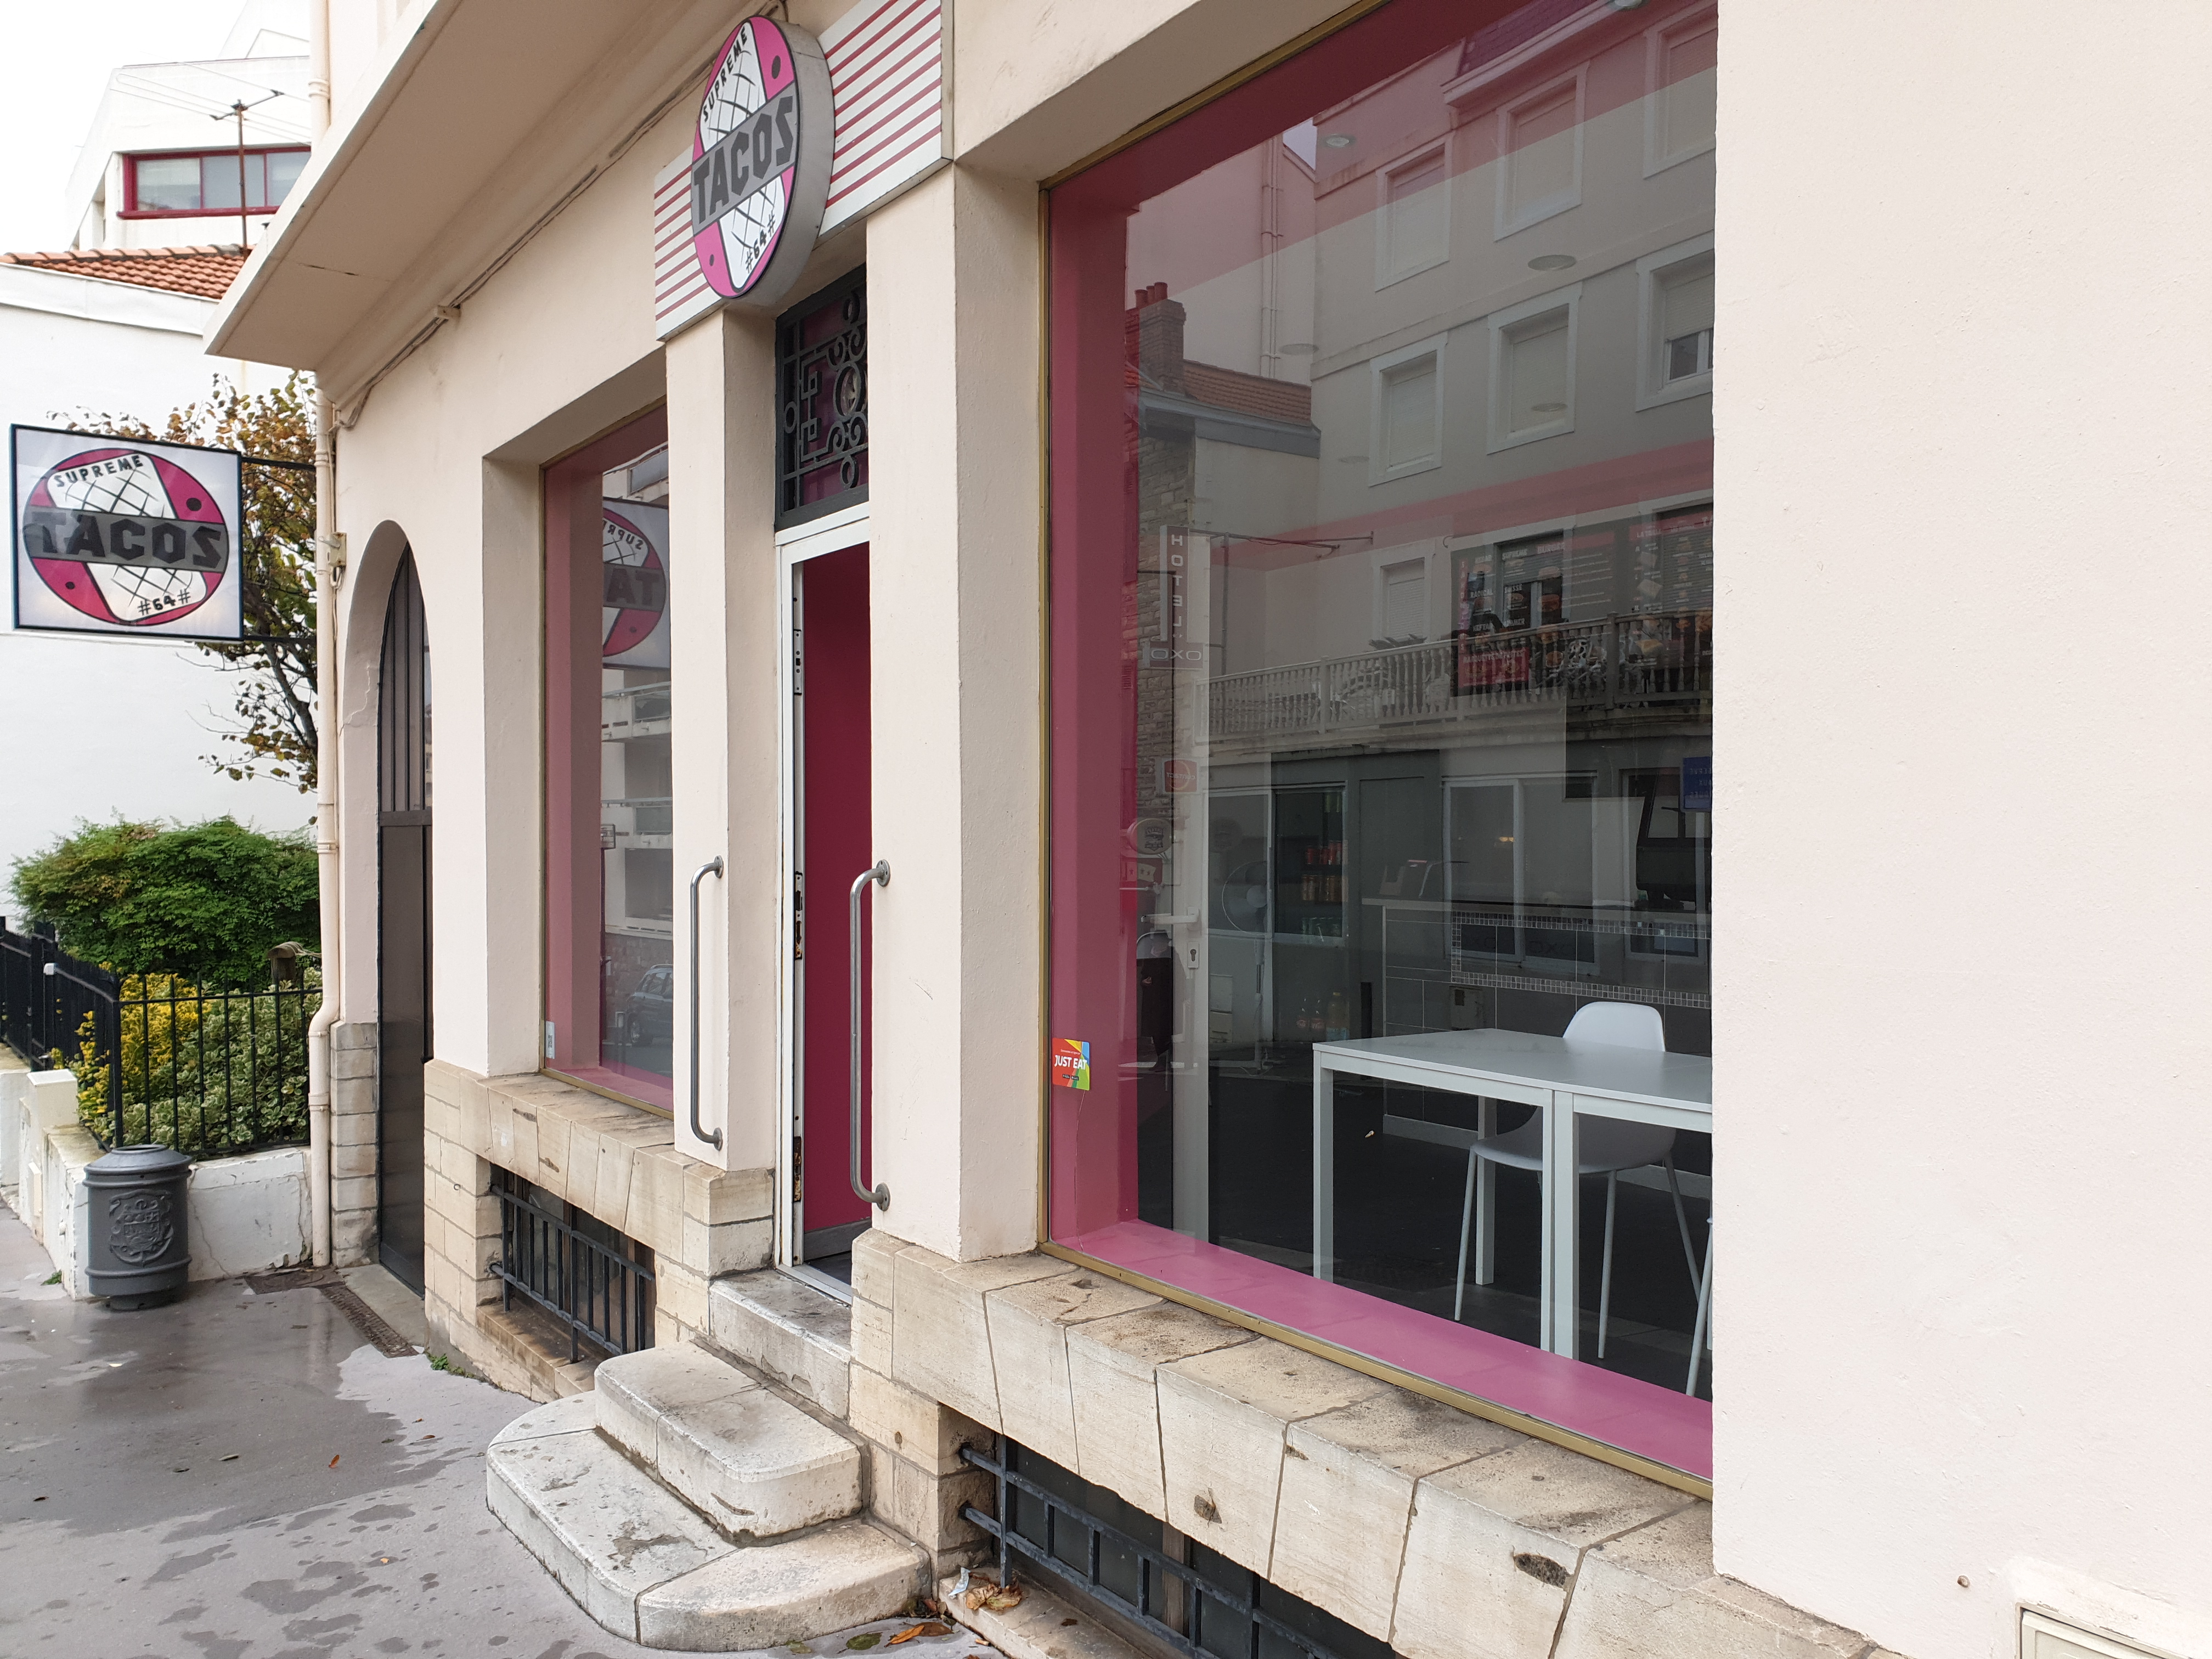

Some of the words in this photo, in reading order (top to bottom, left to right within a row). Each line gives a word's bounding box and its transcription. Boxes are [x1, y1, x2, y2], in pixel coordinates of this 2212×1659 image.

[703, 27, 747, 122] SUPREME
[694, 96, 793, 224] TACOS
[746, 213, 776, 274] #64#
[54, 455, 144, 487] SUPREME
[31, 511, 222, 569] TACOS
[137, 589, 191, 616] #64#
[1054, 1054, 1072, 1068] JUST
[1073, 1058, 1087, 1070] EAT
